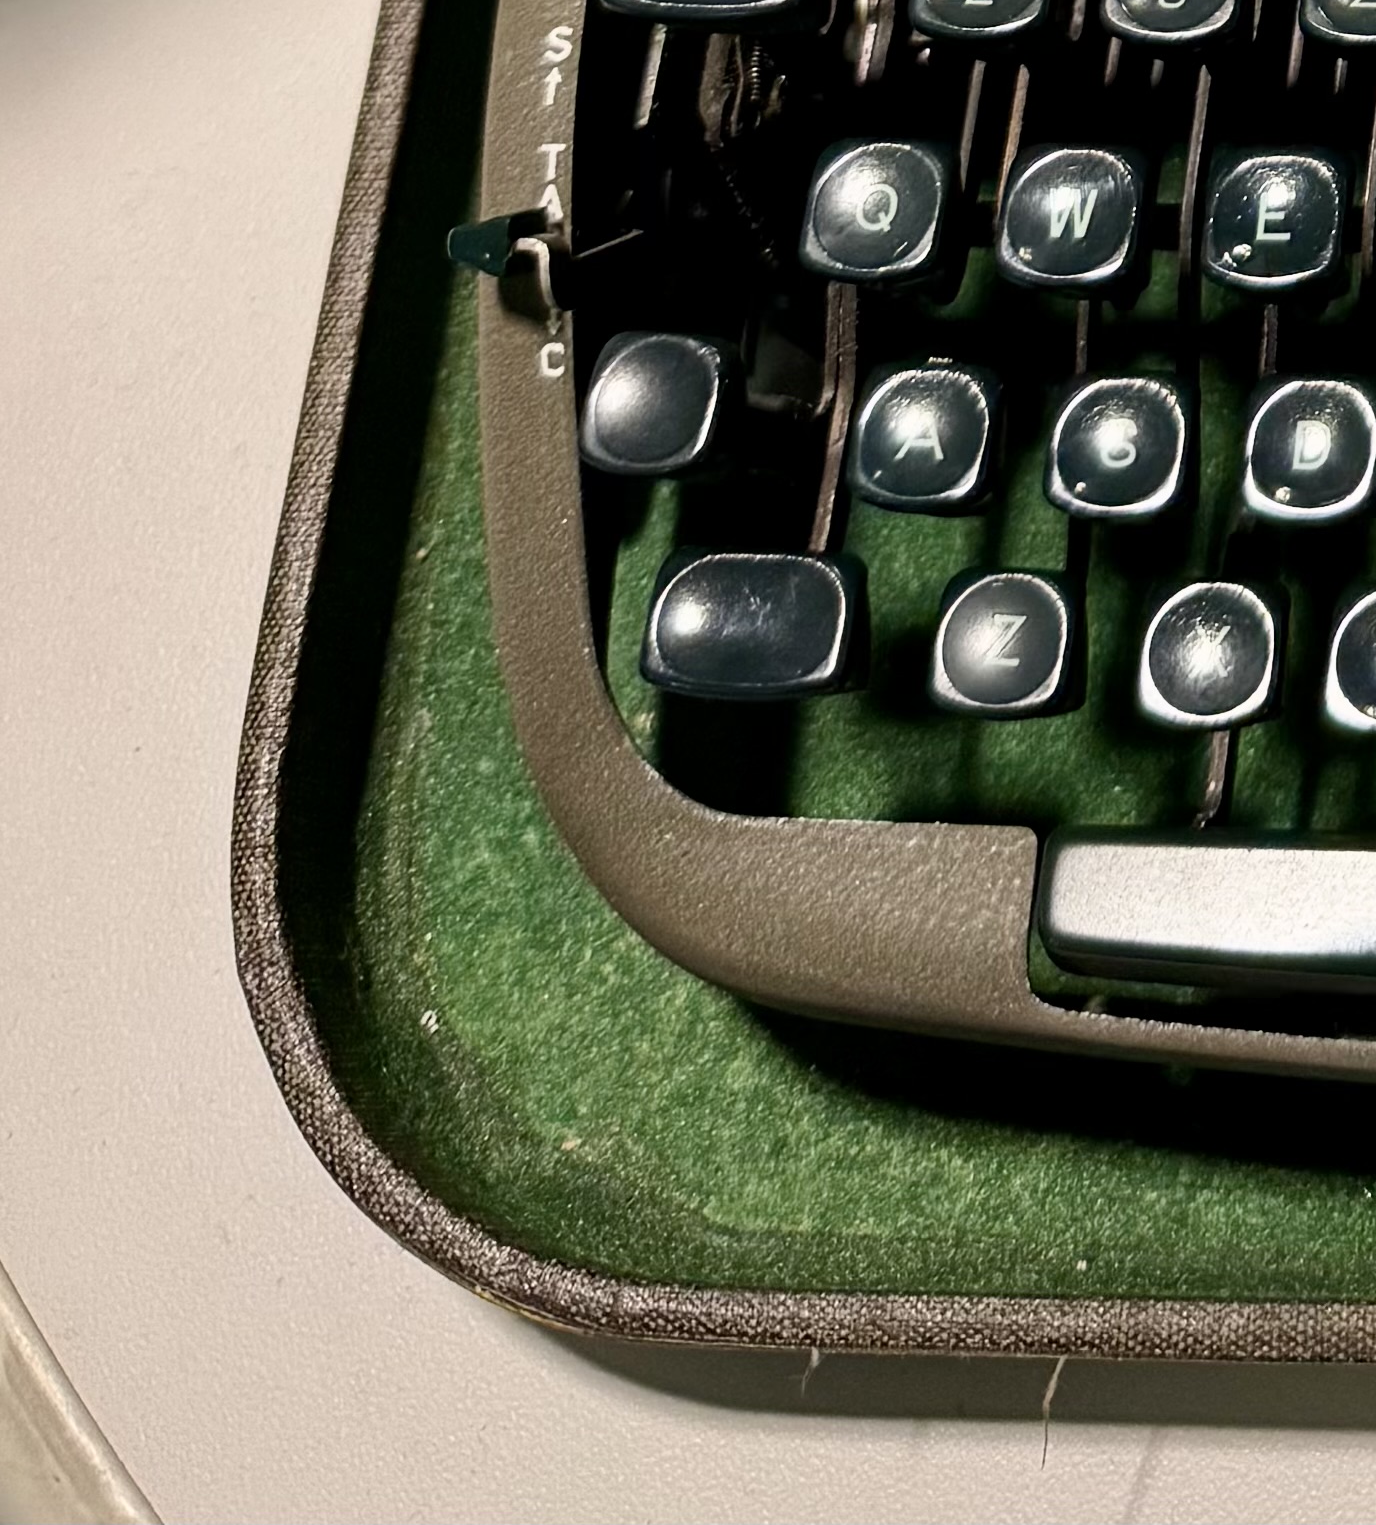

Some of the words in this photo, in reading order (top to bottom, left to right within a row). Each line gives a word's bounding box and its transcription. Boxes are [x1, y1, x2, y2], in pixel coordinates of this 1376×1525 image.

[855, 182, 900, 234] Q
[1049, 186, 1099, 240] W
[1254, 191, 1292, 243] E
[893, 416, 944, 463] A
[1292, 419, 1333, 471] D
[981, 612, 1029, 669] Z
